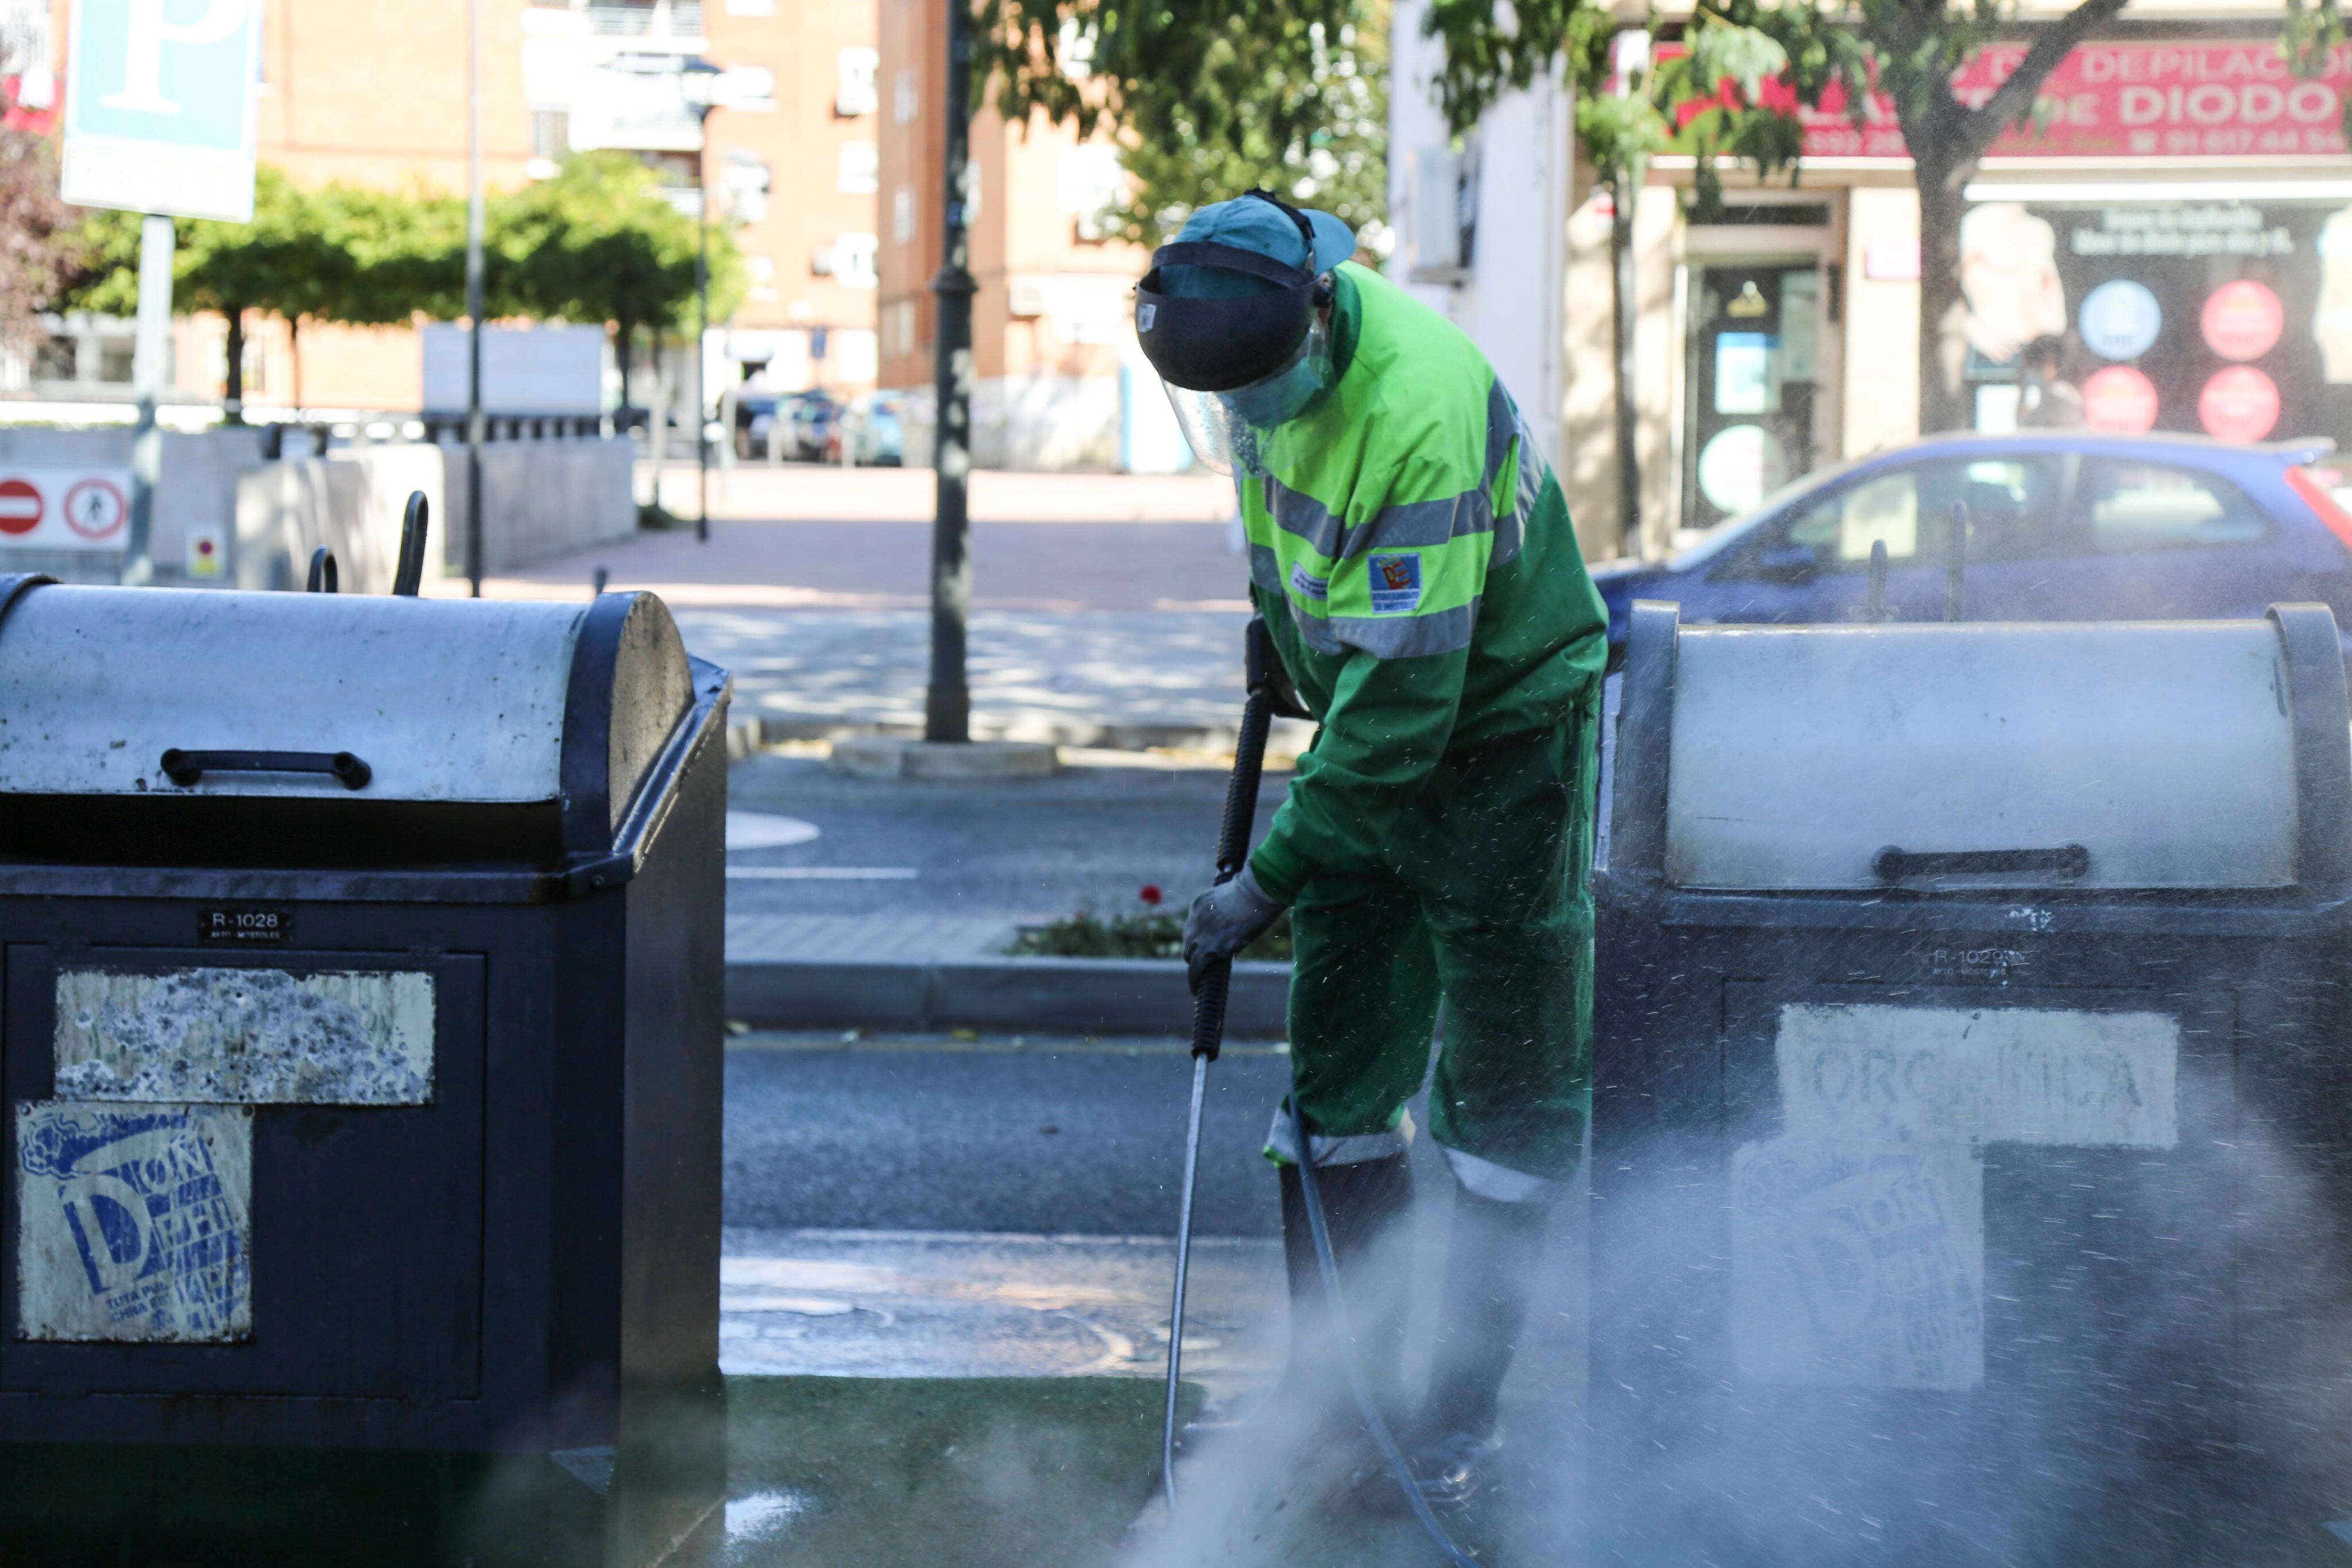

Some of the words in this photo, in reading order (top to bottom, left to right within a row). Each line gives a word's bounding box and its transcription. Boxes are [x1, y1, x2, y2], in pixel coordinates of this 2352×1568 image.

[2119, 82, 2339, 126] DIODO
[212, 912, 278, 928] R-1028
[1935, 950, 2003, 965] R-1029
